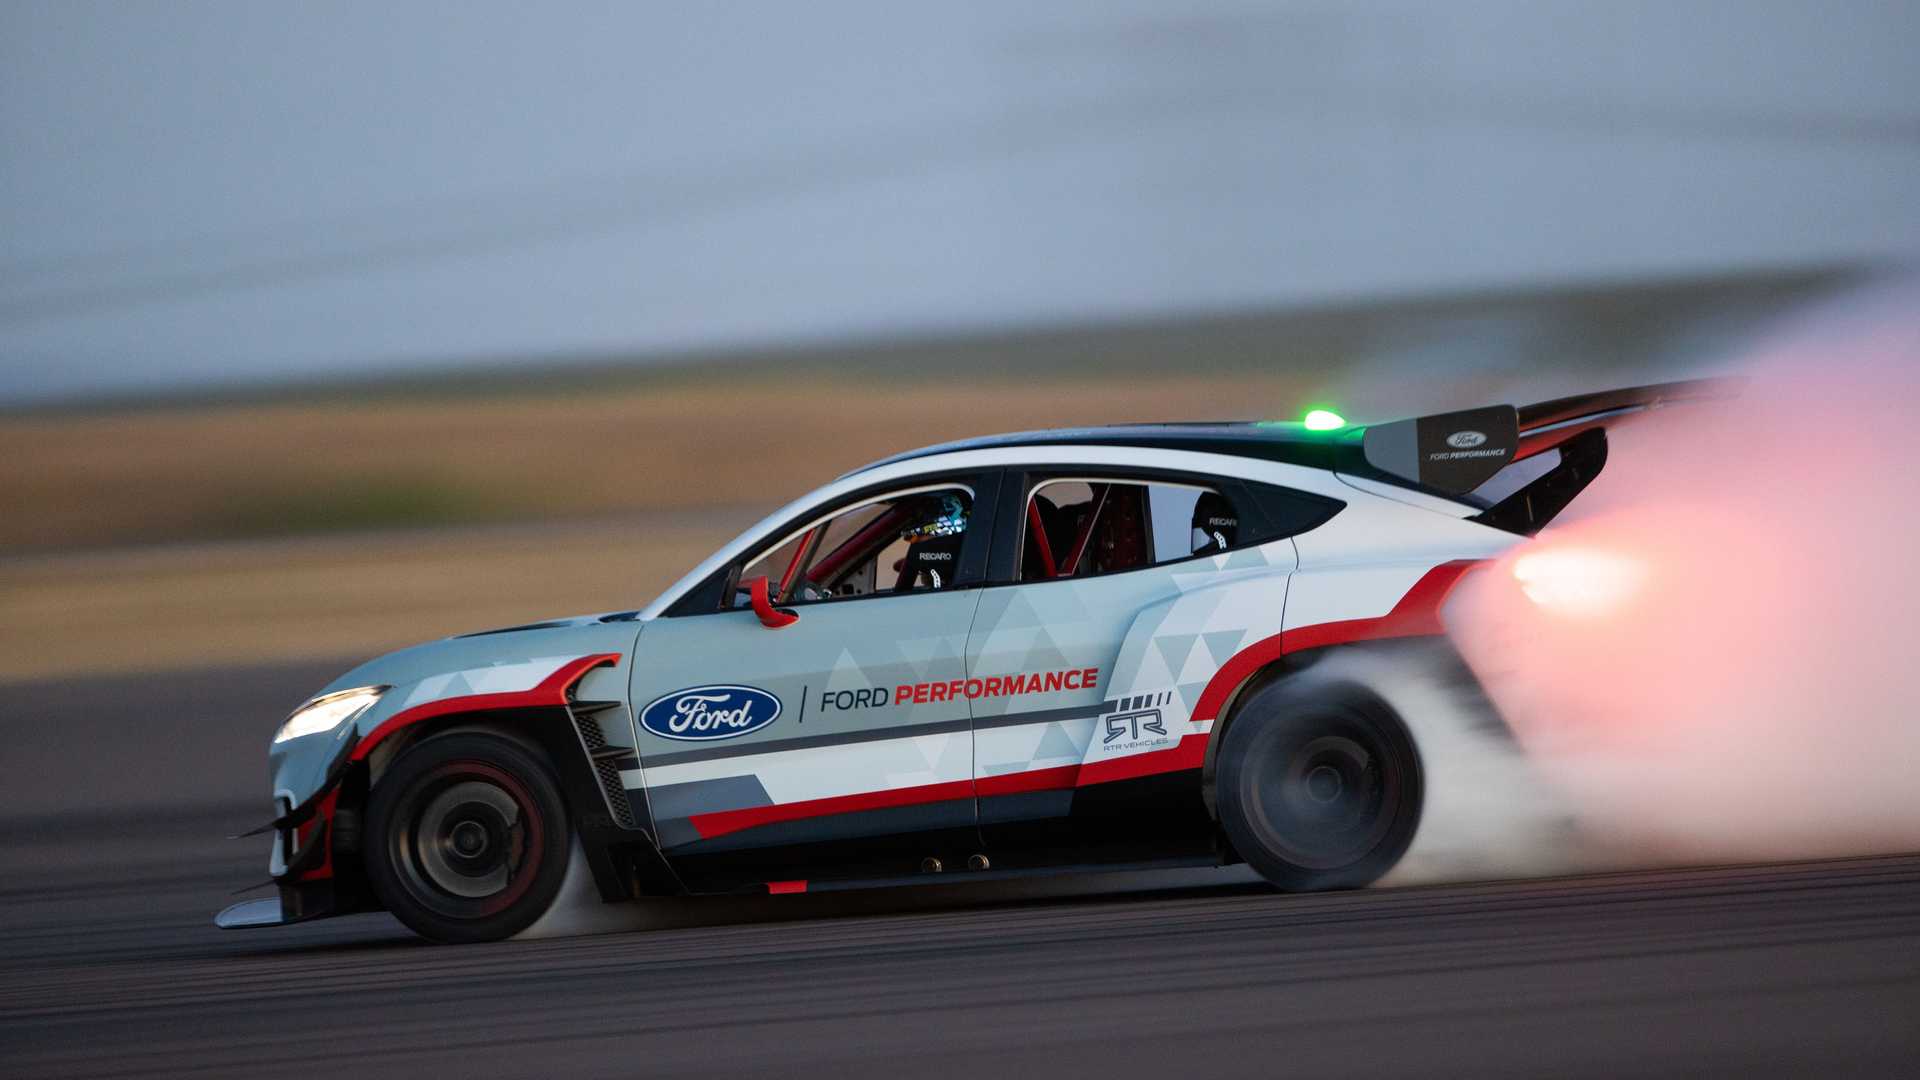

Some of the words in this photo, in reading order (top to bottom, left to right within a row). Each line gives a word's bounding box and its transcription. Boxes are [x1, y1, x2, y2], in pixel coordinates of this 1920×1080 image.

[1455, 434, 1479, 447] Ford
[1450, 448, 1506, 459] PERFORMANCE
[1209, 517, 1237, 526] RECAR
[920, 552, 952, 560] RECARO
[820, 687, 889, 712] FORD
[894, 668, 1099, 705] PERFORMANCE
[668, 693, 753, 733] Ford
[1104, 744, 1122, 752] RTR
[1124, 737, 1169, 749] VEHICLES
